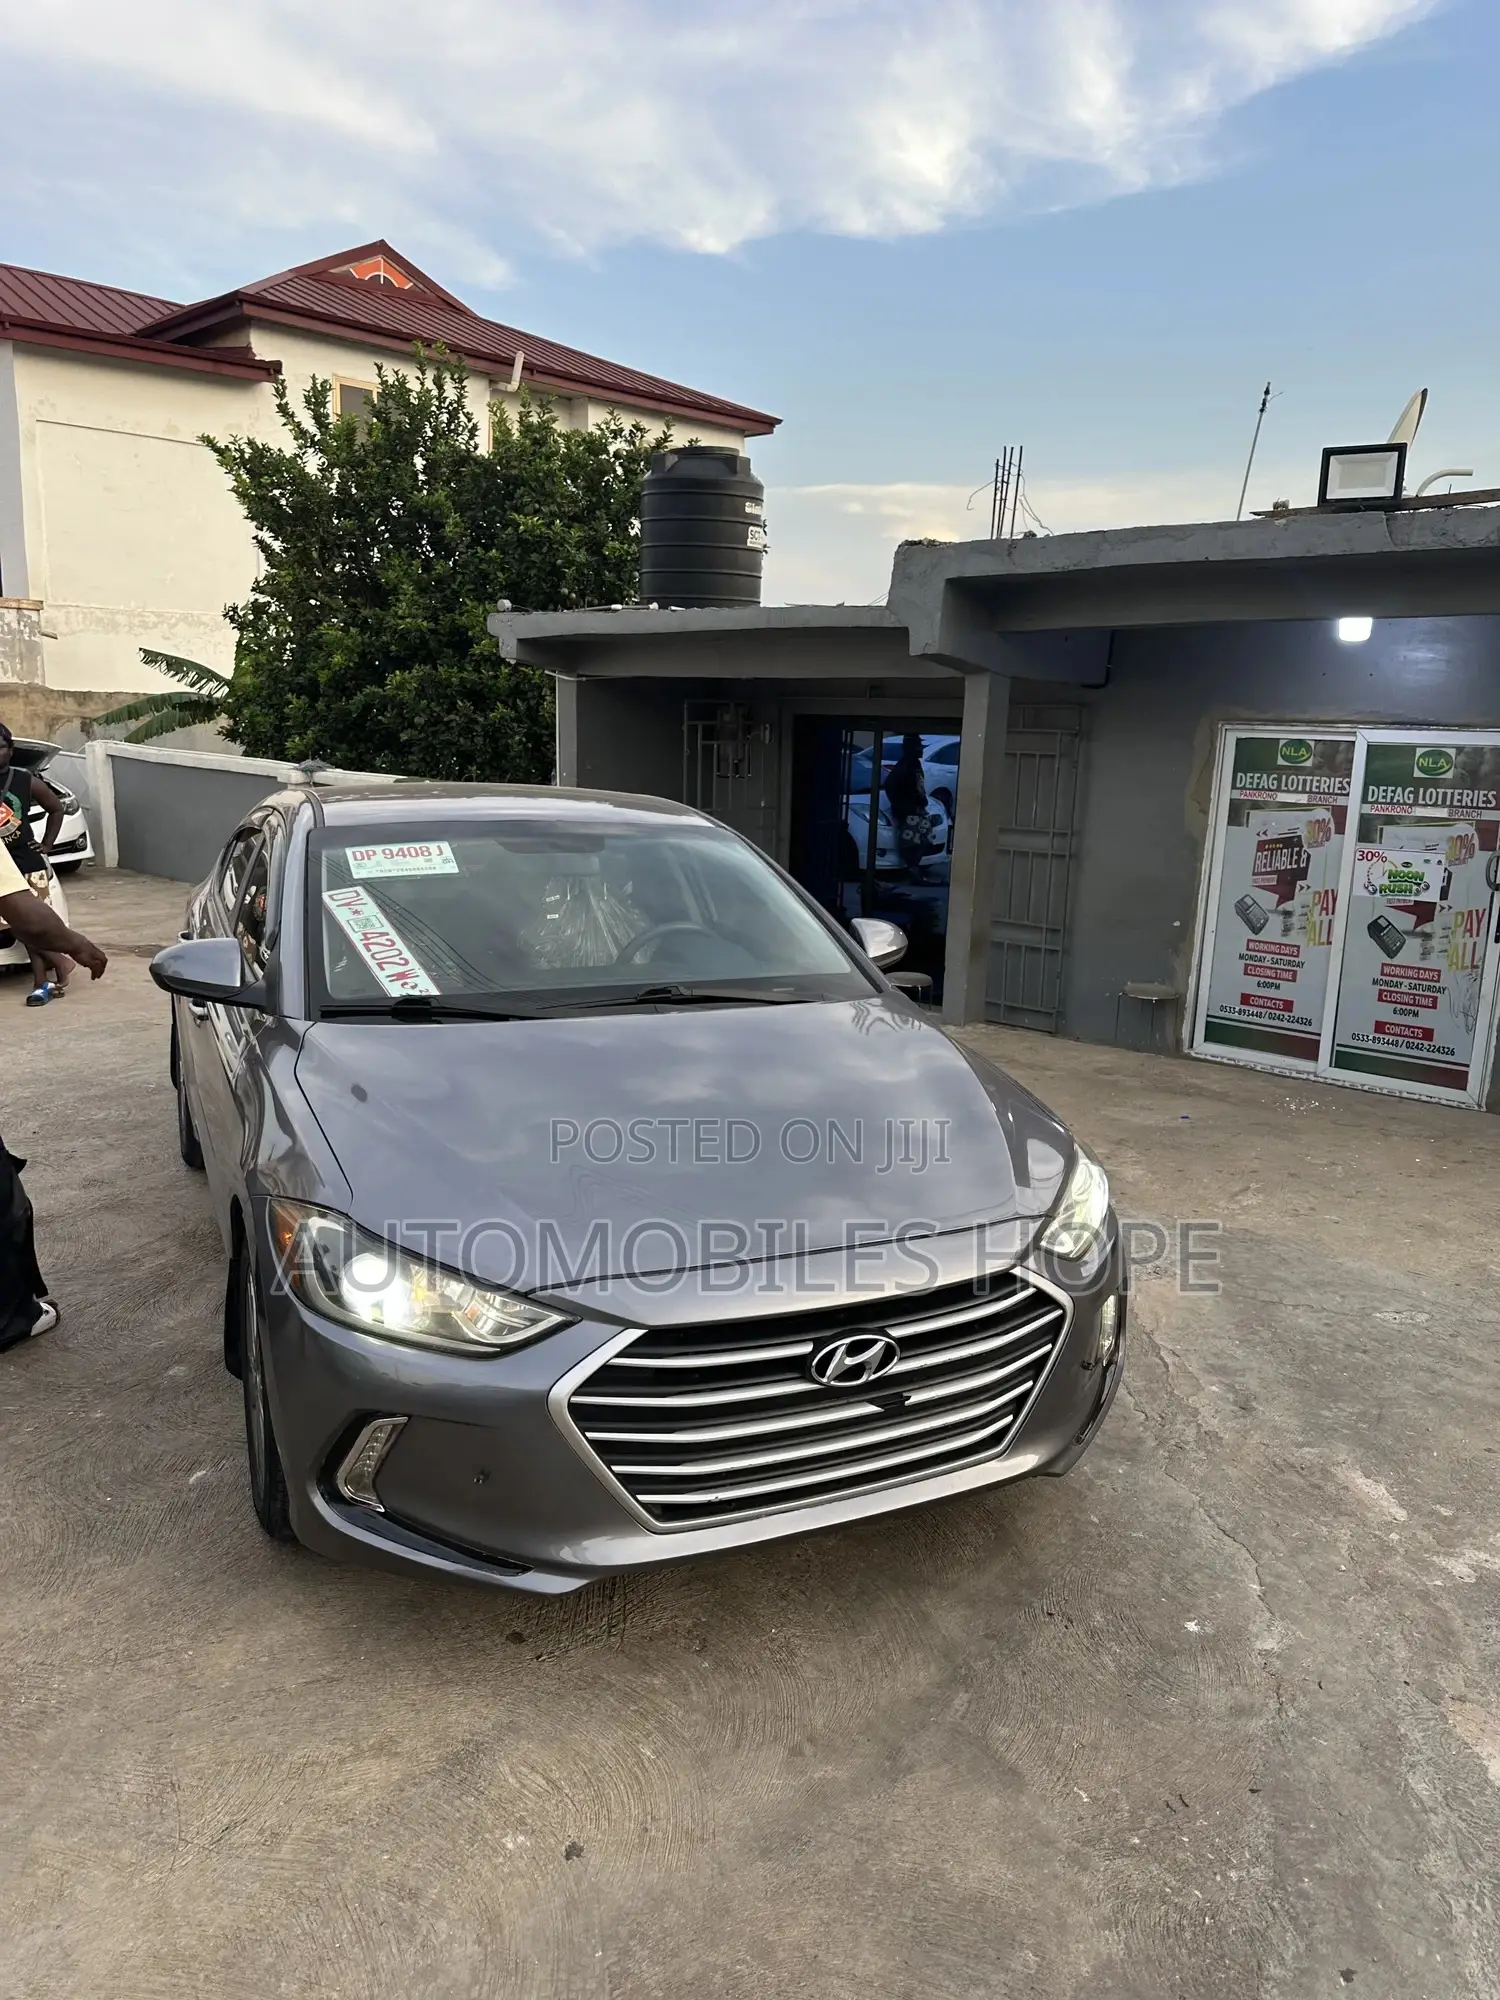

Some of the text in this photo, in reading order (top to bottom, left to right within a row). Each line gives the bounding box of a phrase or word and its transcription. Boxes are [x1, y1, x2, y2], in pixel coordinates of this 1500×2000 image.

[1281, 747, 1308, 757] NLA
[1418, 757, 1448, 768] NLA
[1236, 772, 1351, 794] DEFAG LOTTERIES
[1239, 790, 1338, 804] PANKRONO BRANCH
[1367, 785, 1497, 808] DEFAG LOTTERIES
[1369, 804, 1483, 819] PANKRONO BRANCH
[351, 844, 444, 862] DP 9408 J
[1254, 847, 1300, 873] RELIABLE
[1356, 850, 1388, 863] 30%
[1378, 883, 1414, 896] RUSH
[328, 889, 368, 907] DV
[1311, 888, 1339, 917] PAY
[1453, 908, 1487, 939] PAY
[1306, 919, 1333, 948] ALL
[1248, 941, 1298, 956] WORKING DAYS
[1447, 941, 1482, 972] ALL
[1239, 953, 1267, 964] MONDAY
[1271, 957, 1306, 969] SATURDAY
[1247, 966, 1293, 980] CLOSING TIME
[1383, 965, 1440, 981] WORKING DAYS
[1256, 980, 1281, 991] 6:00PM
[1372, 977, 1403, 989] MONDAY
[1408, 983, 1447, 995] SATURDAY
[1249, 996, 1284, 1010] CONTACTS
[1382, 991, 1434, 1007] CLOSING TIME
[1219, 1004, 1263, 1019] 0533-893448
[1268, 1012, 1313, 1027] 0242-224326
[1392, 1006, 1420, 1018] 6:00PM
[1384, 1024, 1424, 1038] CONTACTS
[1351, 1032, 1399, 1048] 0533-893448
[1405, 1040, 1456, 1057] 0242-224326
